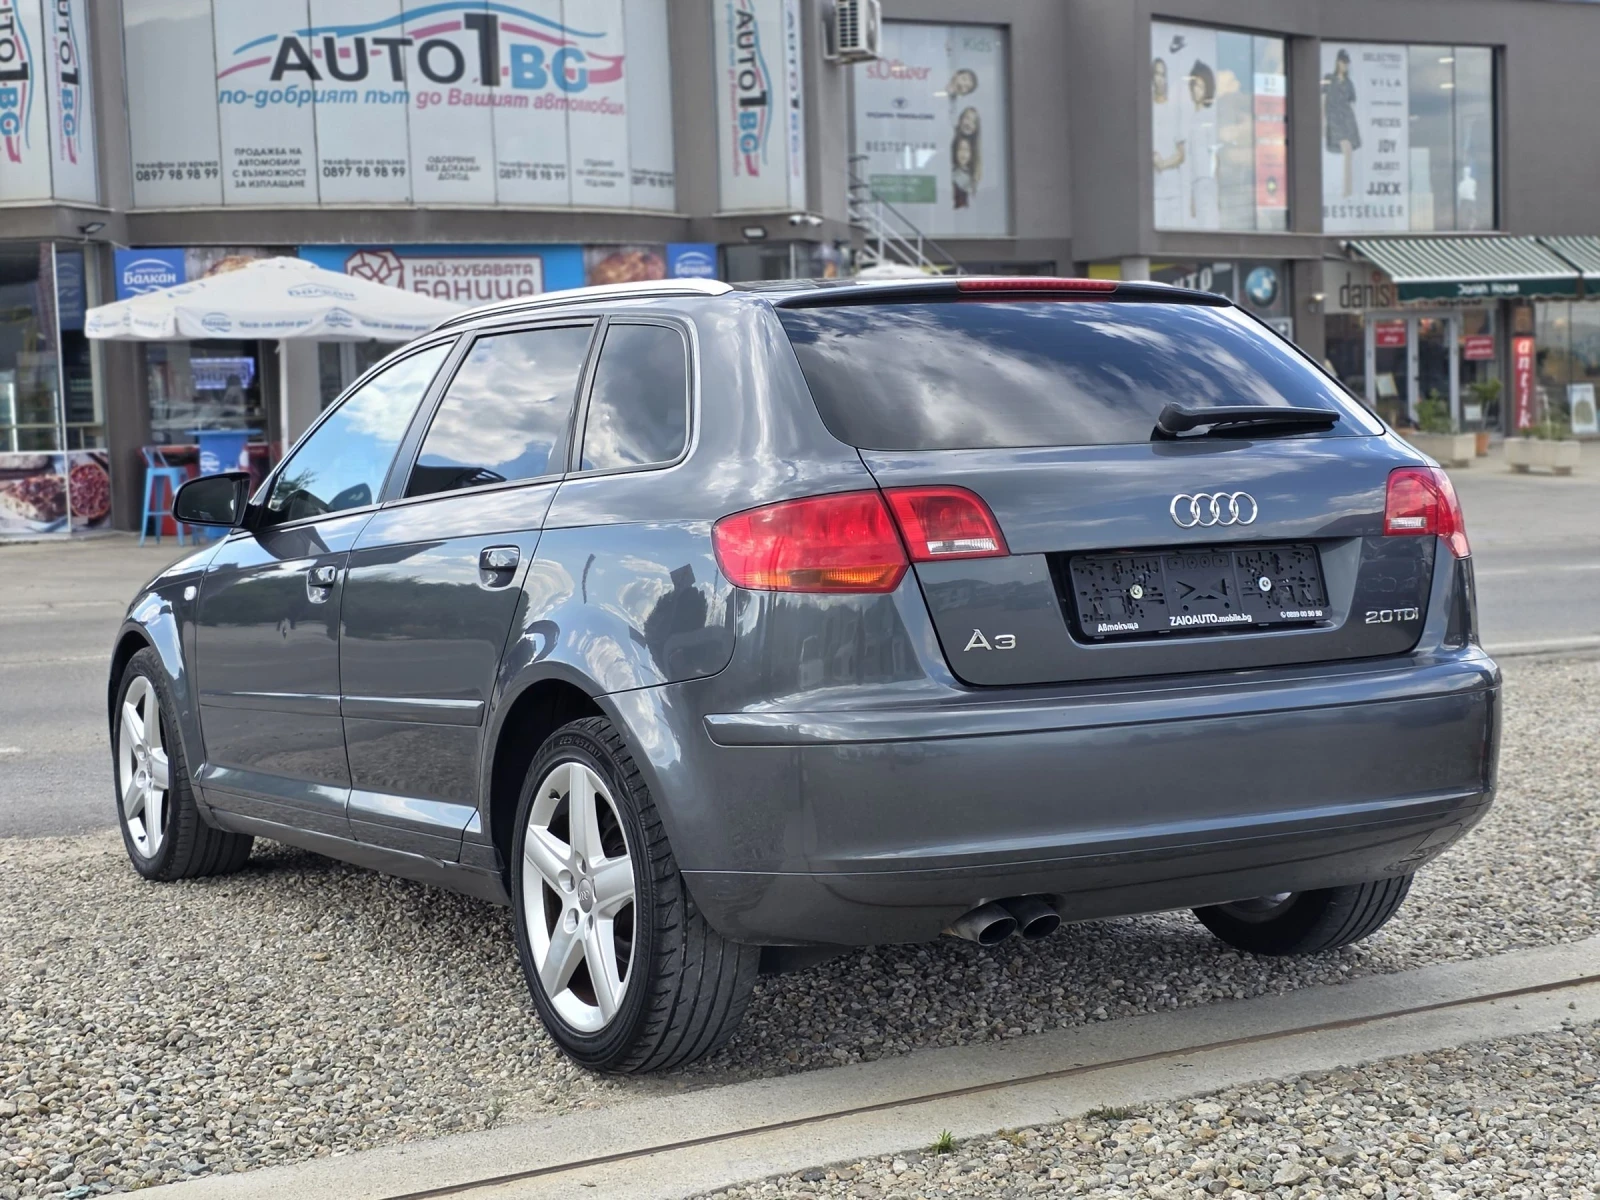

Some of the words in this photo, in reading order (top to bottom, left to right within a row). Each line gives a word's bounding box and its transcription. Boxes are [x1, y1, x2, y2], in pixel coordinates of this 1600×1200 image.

[416, 90, 442, 109] до
[447, 87, 529, 109] Вашият
[237, 159, 301, 167] АВТОМОБИЛИ
[135, 170, 165, 182] 0897
[168, 169, 183, 180] 98
[186, 168, 202, 180] 98
[204, 167, 219, 179] 99
[322, 166, 352, 178] 0897
[356, 166, 370, 177] 98
[374, 166, 388, 178] 98
[391, 166, 406, 177] 99
[1366, 181, 1402, 195] JJXX
[412, 260, 534, 277] НАЙ-ХУБАВАТА
[123, 271, 177, 286] Балкан
[963, 628, 1017, 652] A3
